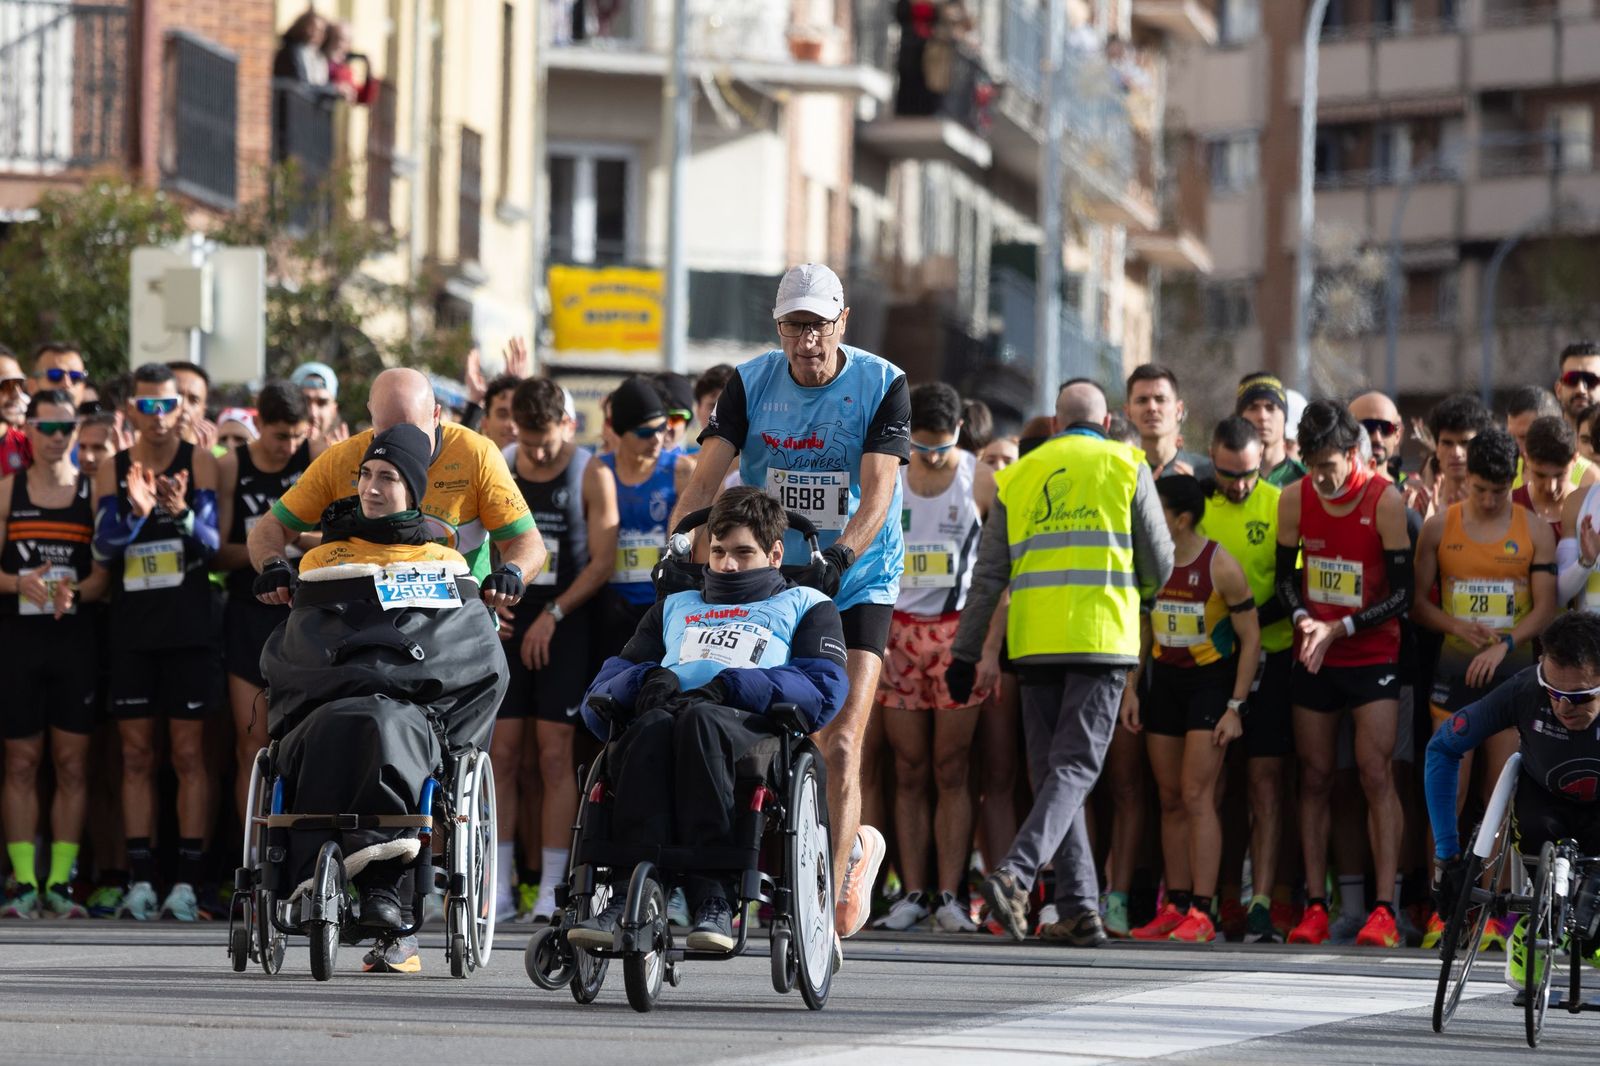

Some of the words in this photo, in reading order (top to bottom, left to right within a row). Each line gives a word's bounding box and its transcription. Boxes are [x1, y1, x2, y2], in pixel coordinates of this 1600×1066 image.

[792, 454, 842, 470] FLOWERS
[787, 473, 841, 486] SETEL
[779, 485, 825, 511] 1698
[619, 539, 659, 548] SETEL
[908, 544, 946, 552] SETEL
[141, 555, 158, 574] 16
[623, 549, 639, 568] 15
[912, 554, 928, 573] 10
[1319, 561, 1358, 573] SETEL
[395, 573, 447, 583] SETEL
[1319, 570, 1343, 591] 102
[387, 583, 440, 600] 2562
[1468, 585, 1508, 593] SETEL
[1162, 603, 1199, 614] SETEL
[1470, 595, 1489, 613] 28
[1168, 614, 1177, 632] 6
[698, 629, 741, 650] 1135
